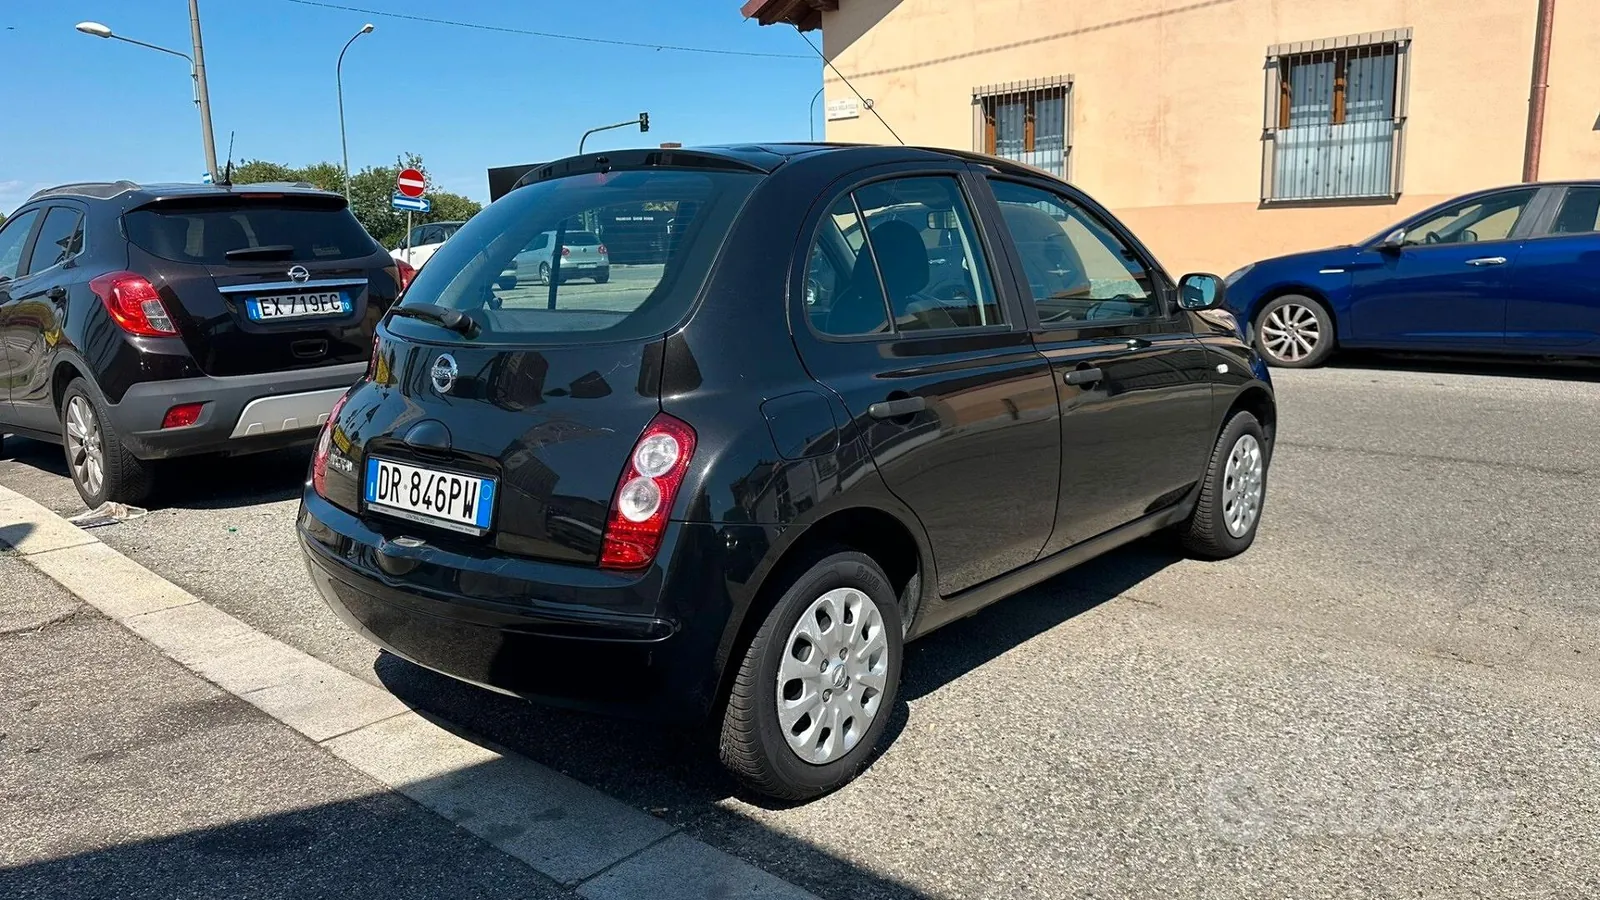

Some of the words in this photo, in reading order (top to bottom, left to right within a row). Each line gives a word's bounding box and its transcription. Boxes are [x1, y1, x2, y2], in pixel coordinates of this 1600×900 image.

[260, 297, 283, 317] EX
[287, 294, 340, 314] 719FC
[378, 465, 402, 503] DR
[409, 471, 478, 519] 846PW
